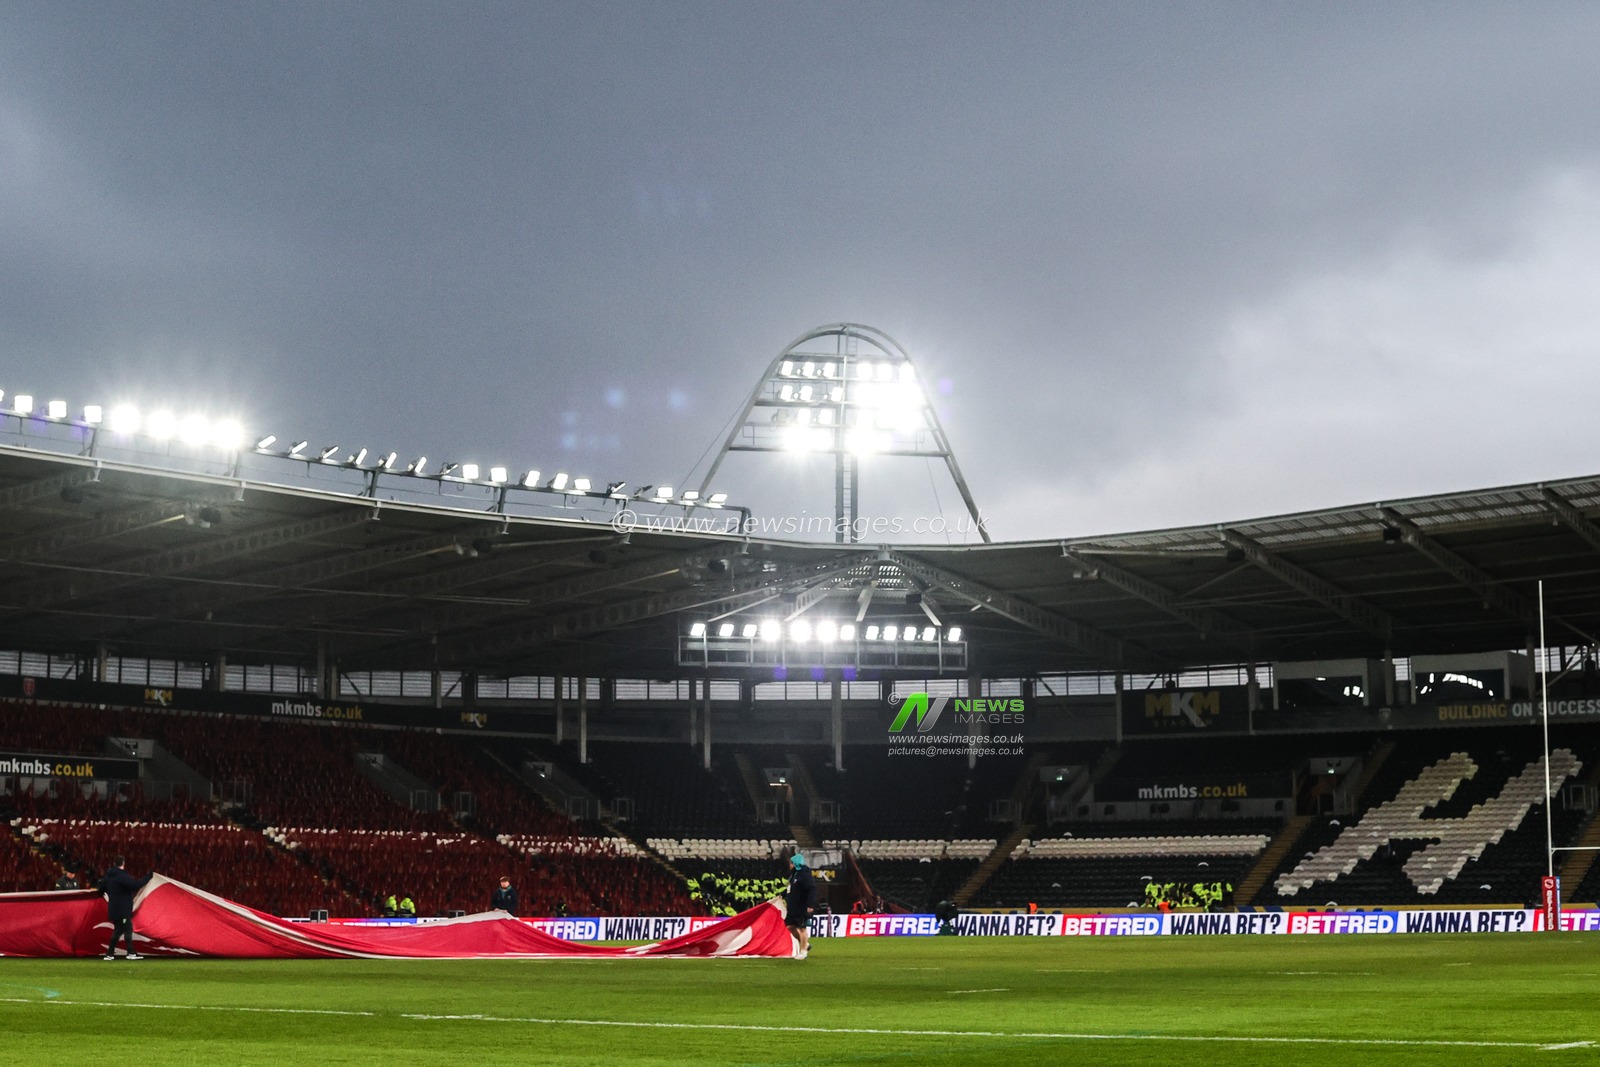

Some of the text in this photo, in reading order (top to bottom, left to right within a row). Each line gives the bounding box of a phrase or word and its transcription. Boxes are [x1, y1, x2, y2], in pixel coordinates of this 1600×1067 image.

[144, 688, 173, 706] MKM
[271, 700, 363, 720] mkmbs.co.uk
[1145, 691, 1220, 727] MKM
[1438, 704, 1507, 720] BUILDING
[1512, 703, 1533, 717] ON
[0, 758, 93, 777] mkmbs.co.uk
[1138, 783, 1248, 799] mkmbs.co.uk
[523, 921, 597, 940] ETFRED
[605, 918, 650, 940] WANNA
[653, 918, 686, 940] BET?
[955, 915, 1056, 936] WANNA BET?
[1065, 917, 1160, 936] BETFRED
[1171, 913, 1281, 935] WANNA BET?
[1290, 915, 1395, 934] BETFRED
[1406, 910, 1527, 933] WANNA BET?
